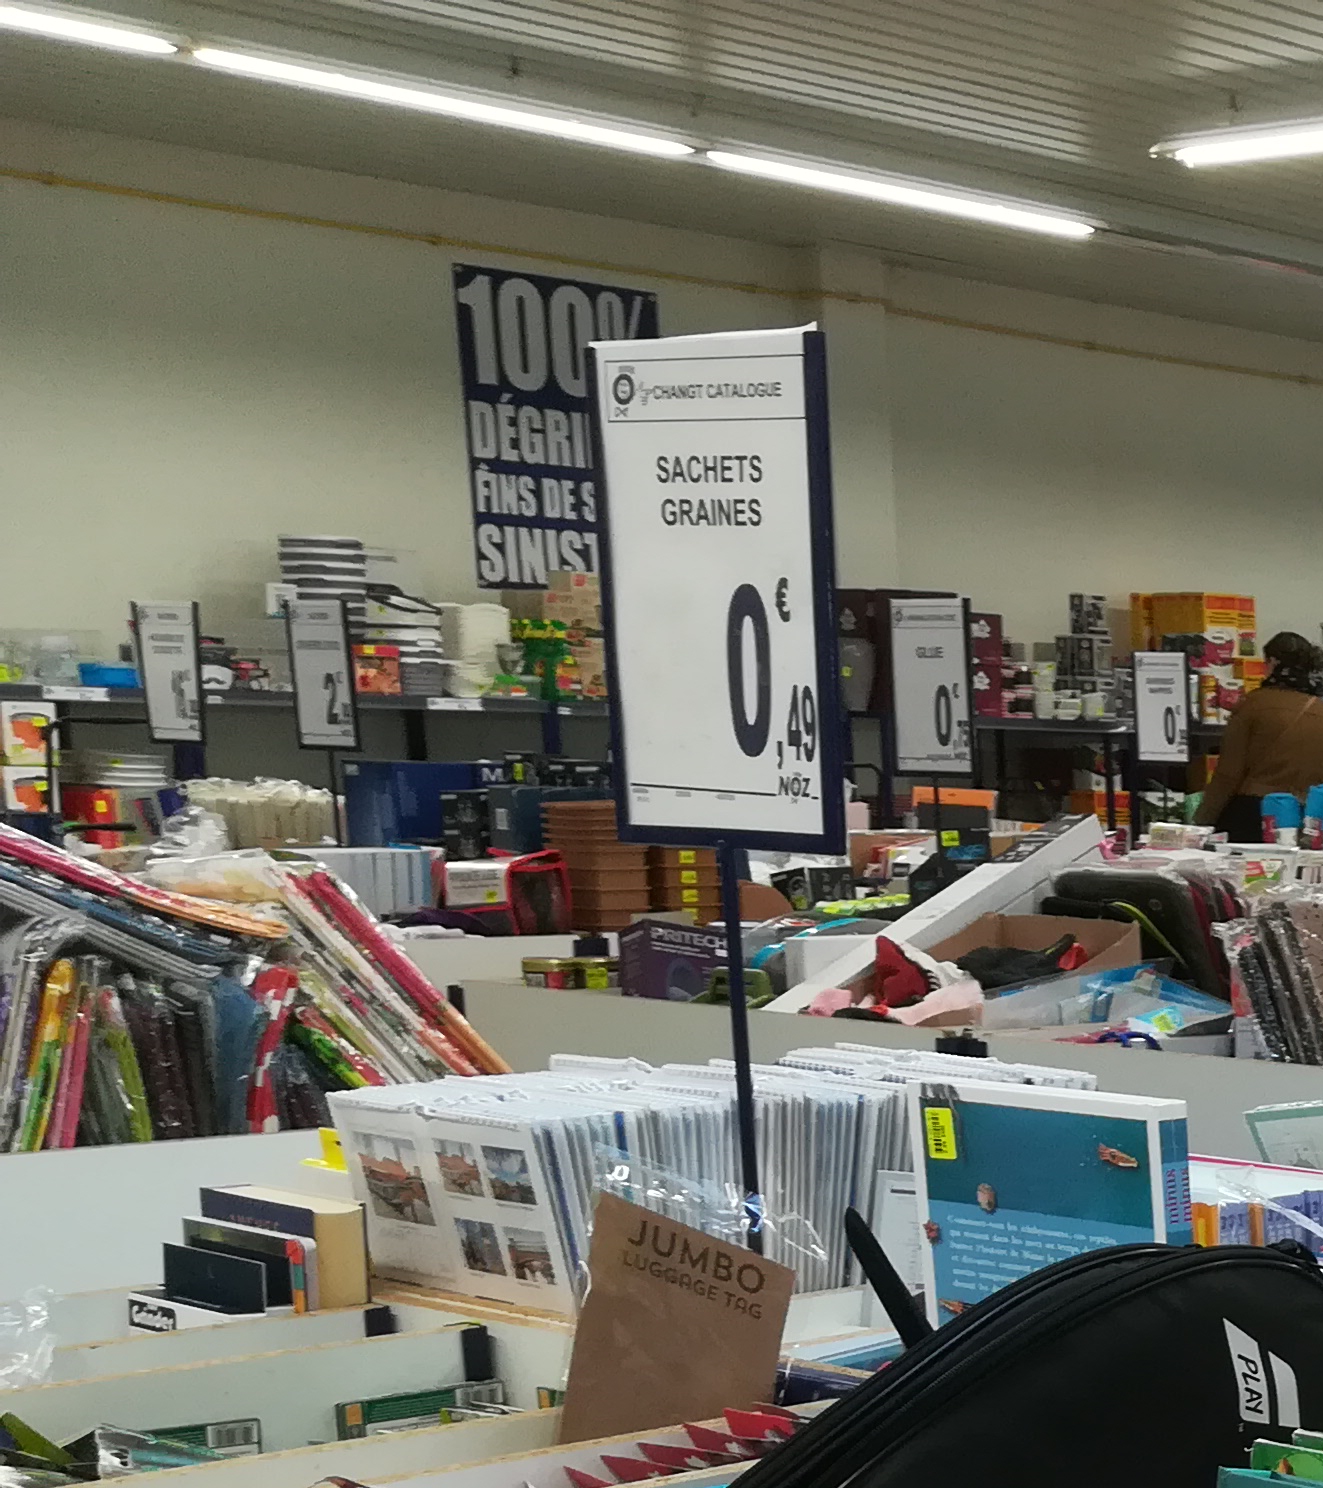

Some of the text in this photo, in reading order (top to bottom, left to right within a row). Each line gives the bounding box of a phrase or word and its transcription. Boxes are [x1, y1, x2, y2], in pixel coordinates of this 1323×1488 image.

[652, 382, 782, 399] CHANGT CATALOGUE
[656, 455, 762, 483] SACHETS
[542, 477, 578, 520] DE
[661, 498, 762, 526] GRAINES
[477, 523, 598, 586] SINIST
[651, 927, 727, 948] PRITECH
[1165, 1169, 1179, 1225] minus
[628, 1220, 765, 1293] JUMBO
[623, 1251, 762, 1320] LUGGAGE TAG
[1238, 1354, 1264, 1414] PLAY
